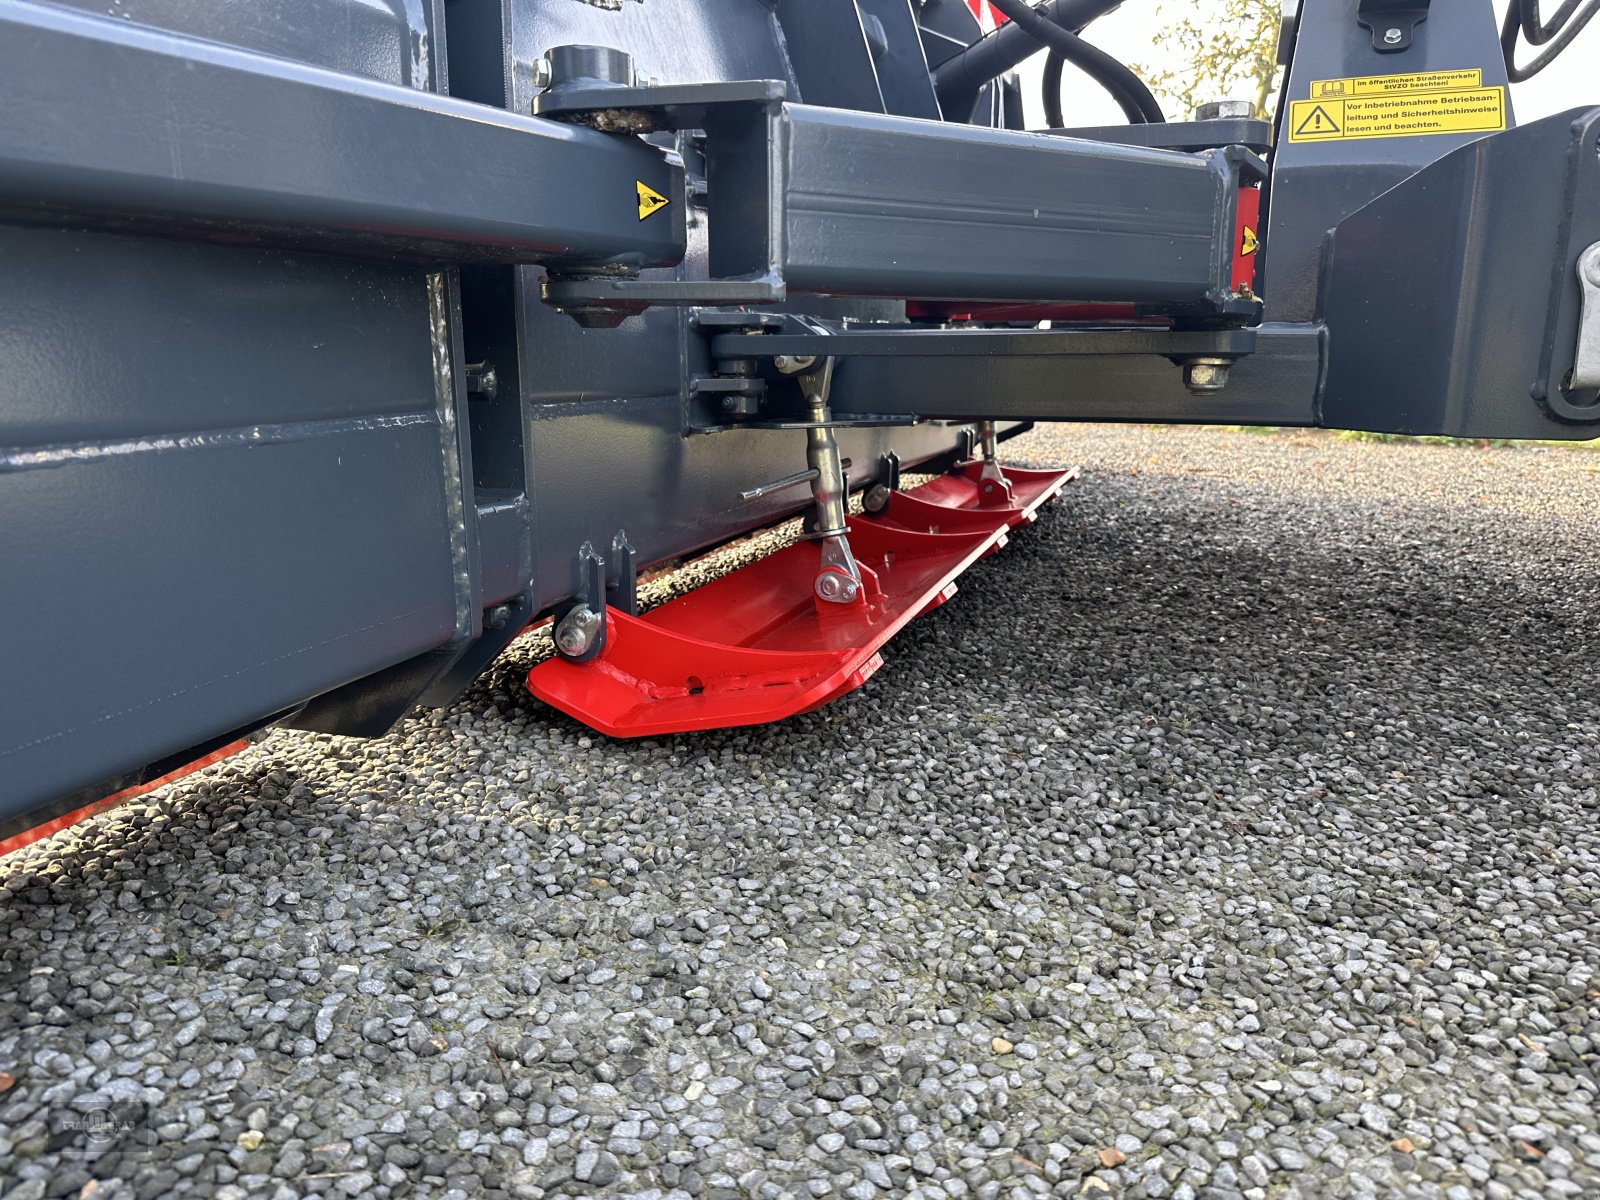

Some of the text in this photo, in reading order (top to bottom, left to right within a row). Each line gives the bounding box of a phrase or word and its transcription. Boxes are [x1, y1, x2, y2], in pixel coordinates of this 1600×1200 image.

[1368, 77, 1414, 86] öffentlichen
[1416, 73, 1476, 82] Straßenverkehr
[1364, 100, 1438, 109] Inbetriebnahme
[1441, 96, 1496, 104] Betriebsan-
[1401, 106, 1498, 118] Sicherheitshinweise
[1394, 122, 1442, 130] beachten.
